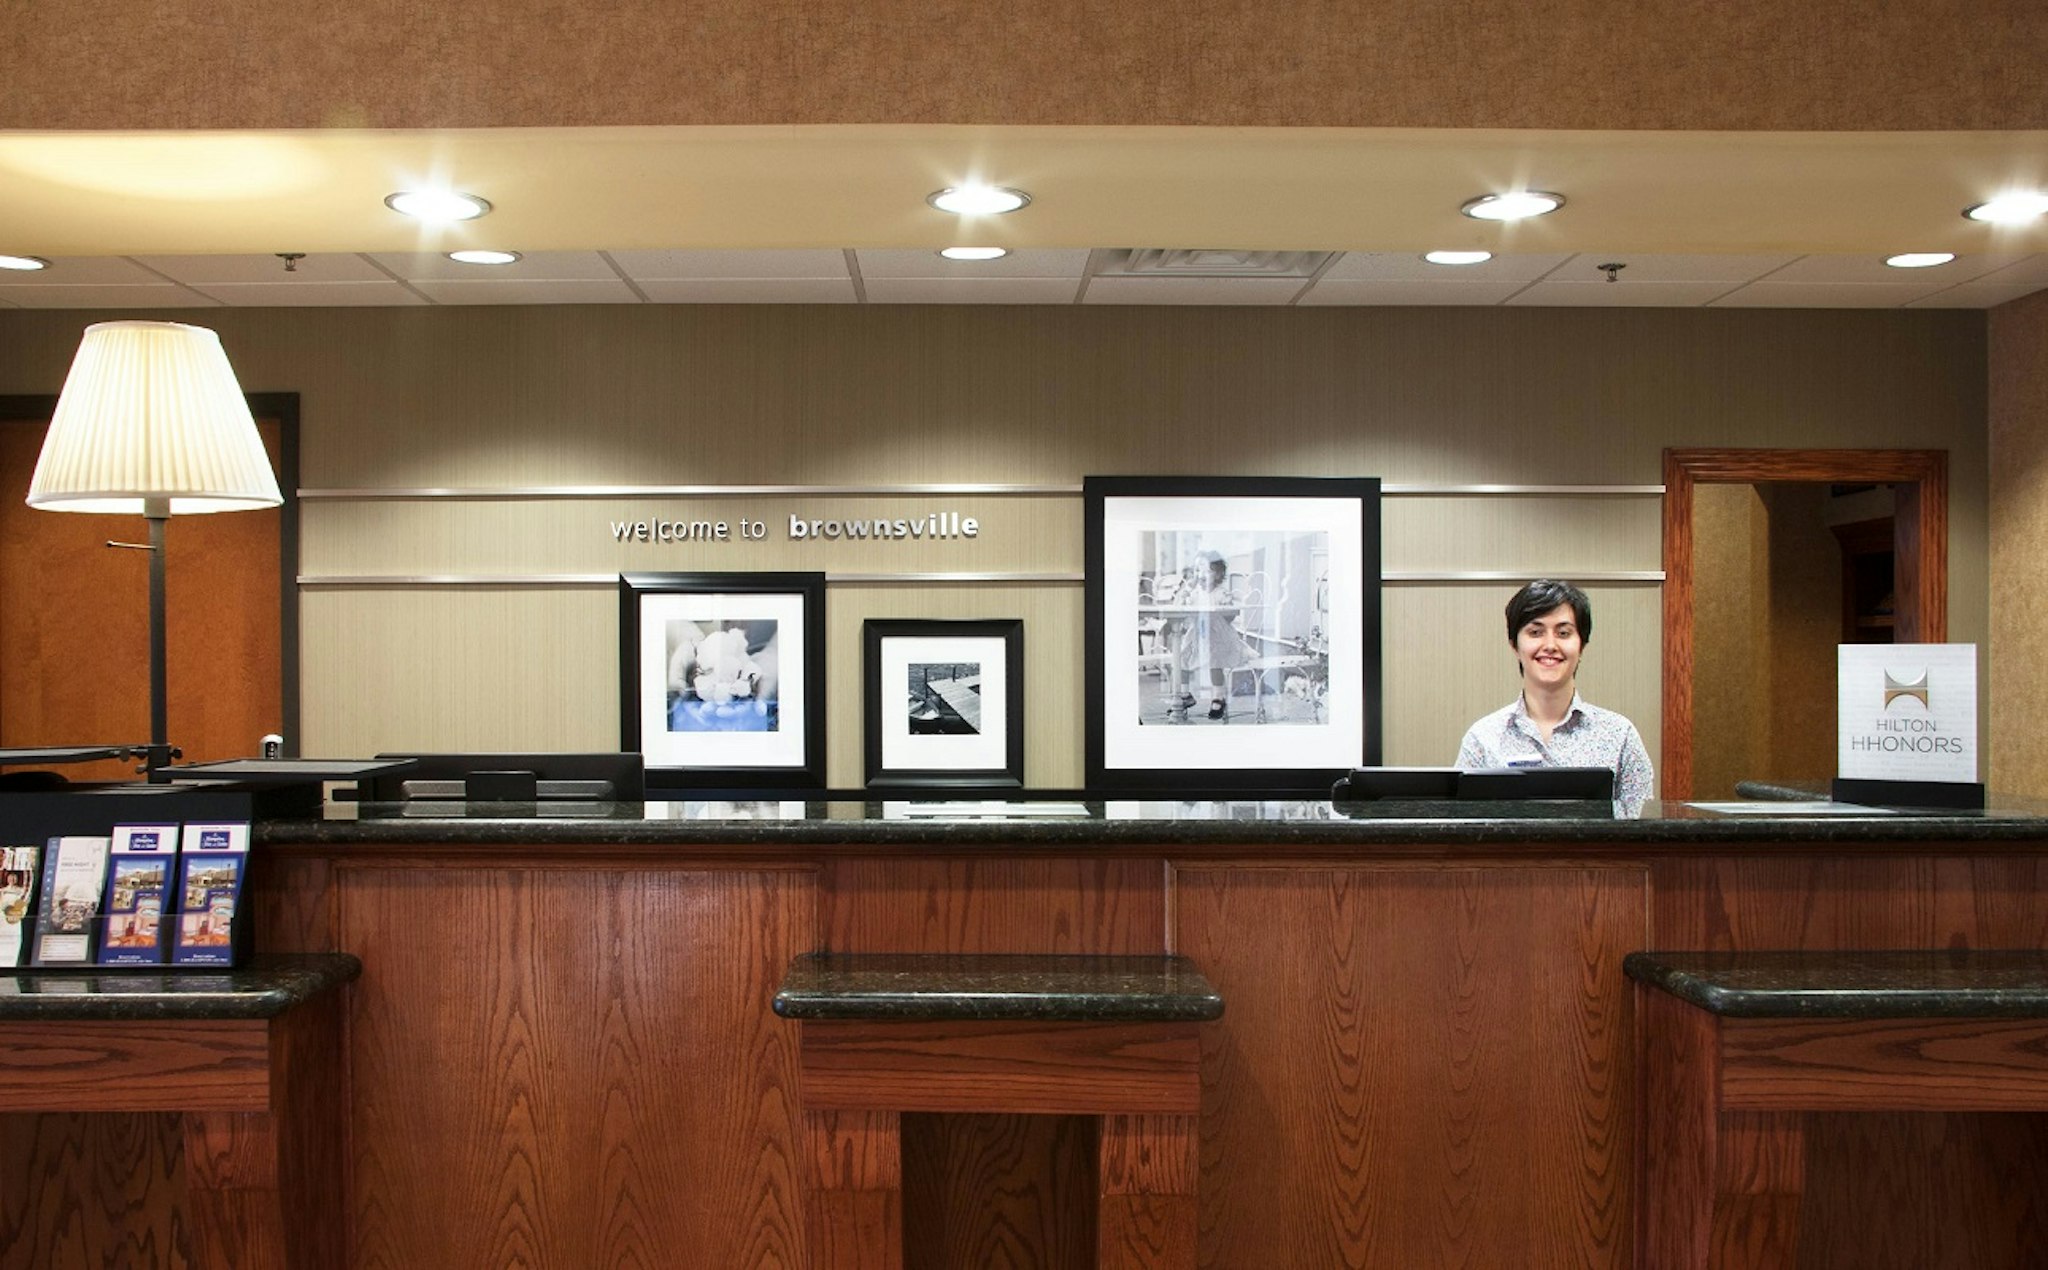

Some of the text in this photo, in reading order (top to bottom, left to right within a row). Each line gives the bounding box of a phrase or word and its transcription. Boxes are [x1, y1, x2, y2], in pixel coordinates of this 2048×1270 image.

[611, 512, 979, 540] welcome to brownsville
[1876, 719, 1937, 732] HILTON
[1852, 736, 1963, 753] HHONORS
